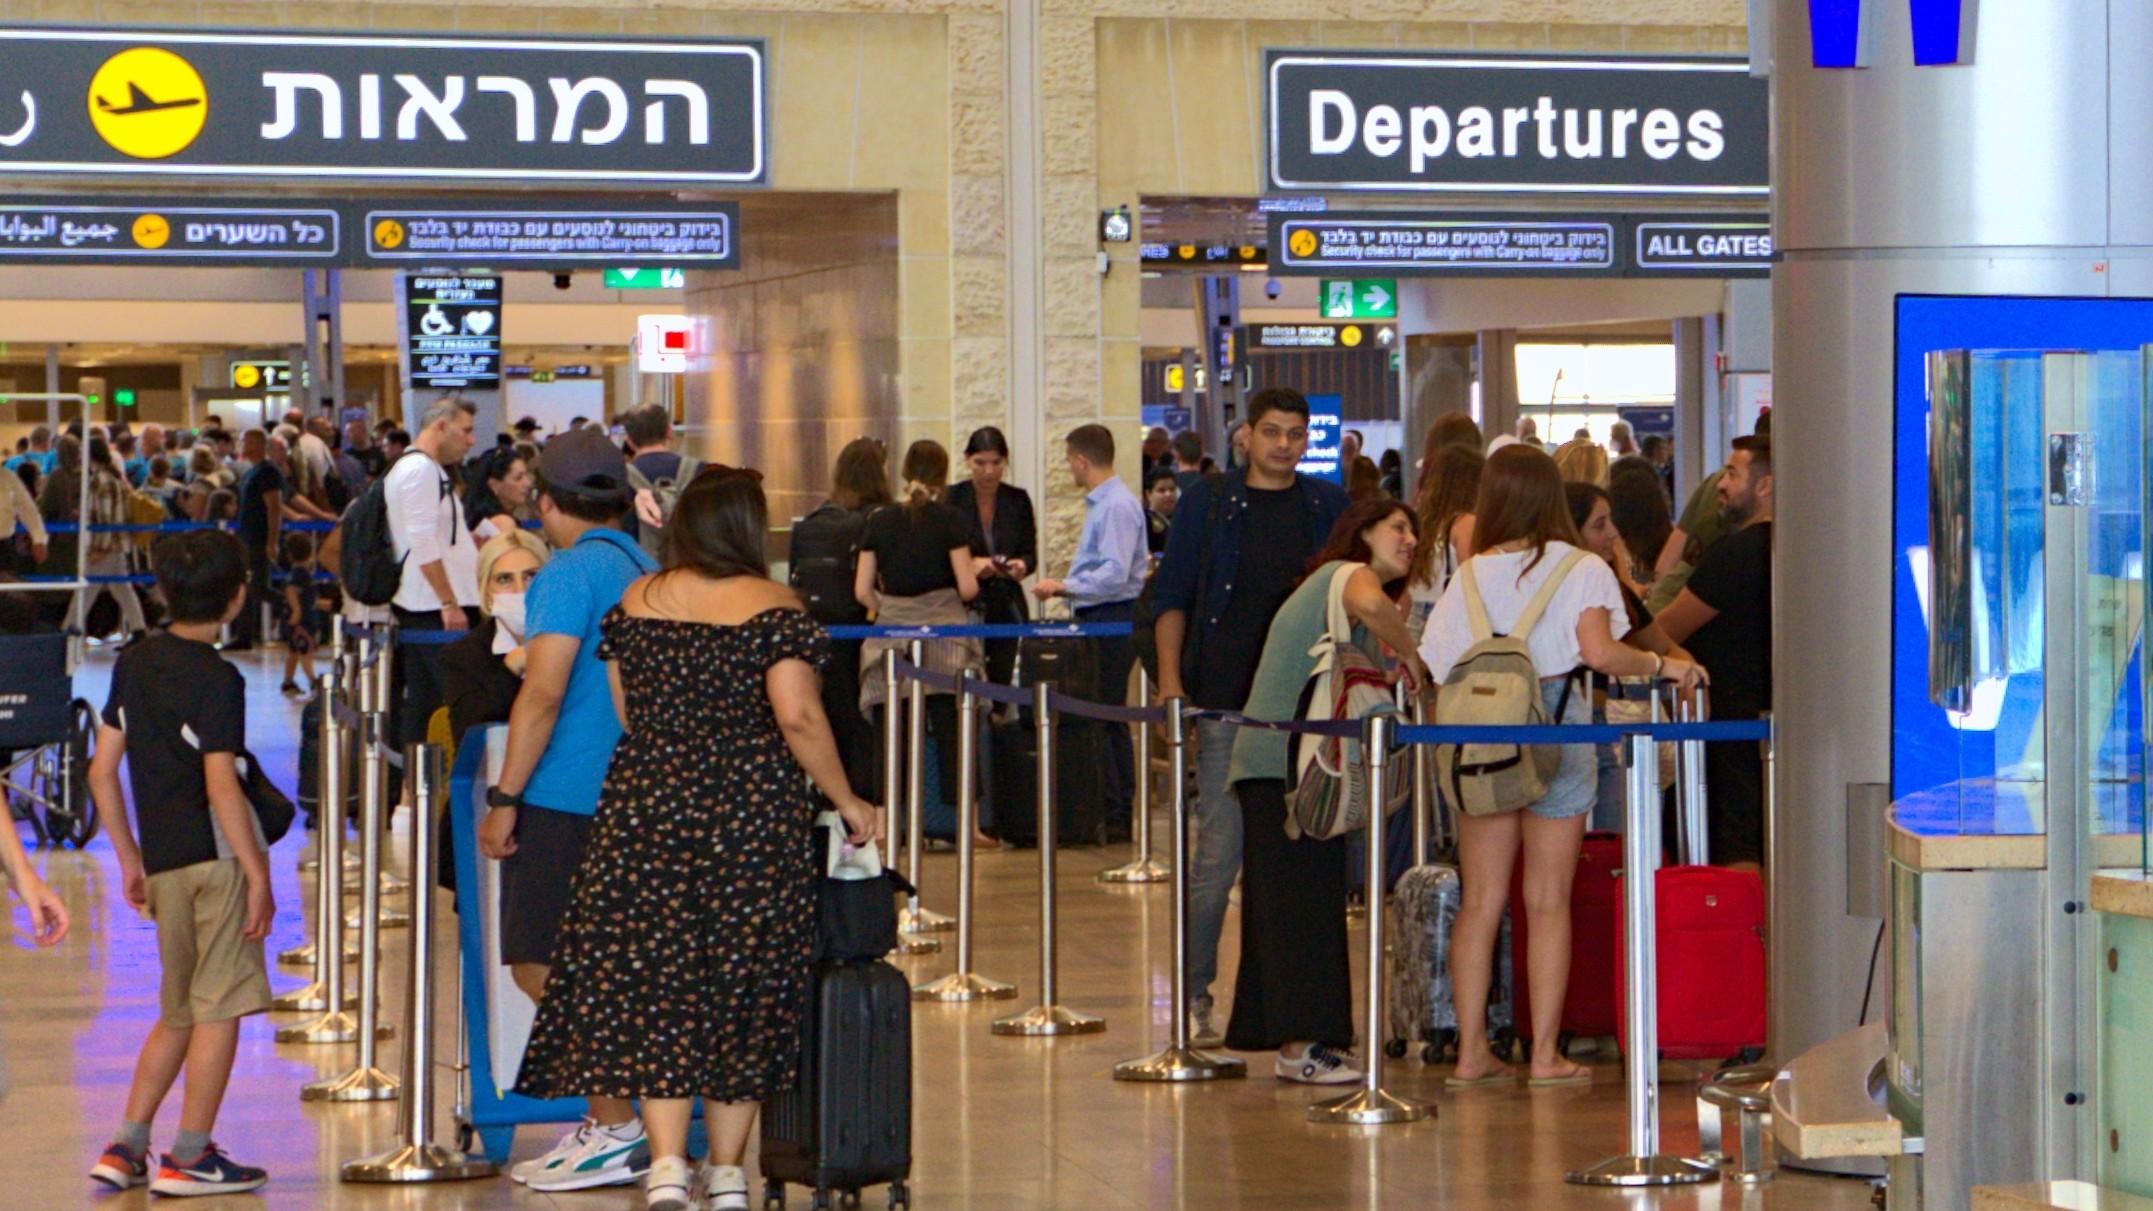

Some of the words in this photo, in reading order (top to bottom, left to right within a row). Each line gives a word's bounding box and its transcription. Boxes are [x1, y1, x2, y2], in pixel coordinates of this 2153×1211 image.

[261, 72, 709, 145] המראות
[1309, 89, 1724, 173] Departures
[0, 215, 57, 242] البوابا
[61, 221, 119, 246] جميع
[185, 223, 286, 244] השערים
[292, 219, 325, 243] כל
[408, 218, 449, 235] בלבד
[452, 222, 468, 235] יד
[524, 222, 548, 237] עם
[552, 219, 615, 236] לנוסעים
[619, 222, 676, 236] ביטחוני
[680, 222, 721, 237] בידוק
[409, 236, 455, 251] Security
[457, 236, 492, 249] check
[493, 236, 509, 249] for
[510, 238, 575, 251] passengers
[697, 237, 721, 252] only
[1320, 228, 1358, 244] בלבד
[1360, 231, 1375, 244] יד
[1426, 232, 1448, 246] עם
[1452, 229, 1509, 246] לנוסעים
[1513, 232, 1564, 246] ביטחוני
[1568, 233, 1606, 247] בידוק
[1321, 244, 1363, 260] Security
[1364, 244, 1396, 257] check
[1397, 244, 1412, 257] for
[1413, 246, 1472, 260] passengers
[1583, 246, 1606, 261] only
[1647, 235, 1694, 256] ALL
[1696, 235, 1772, 256] GATES
